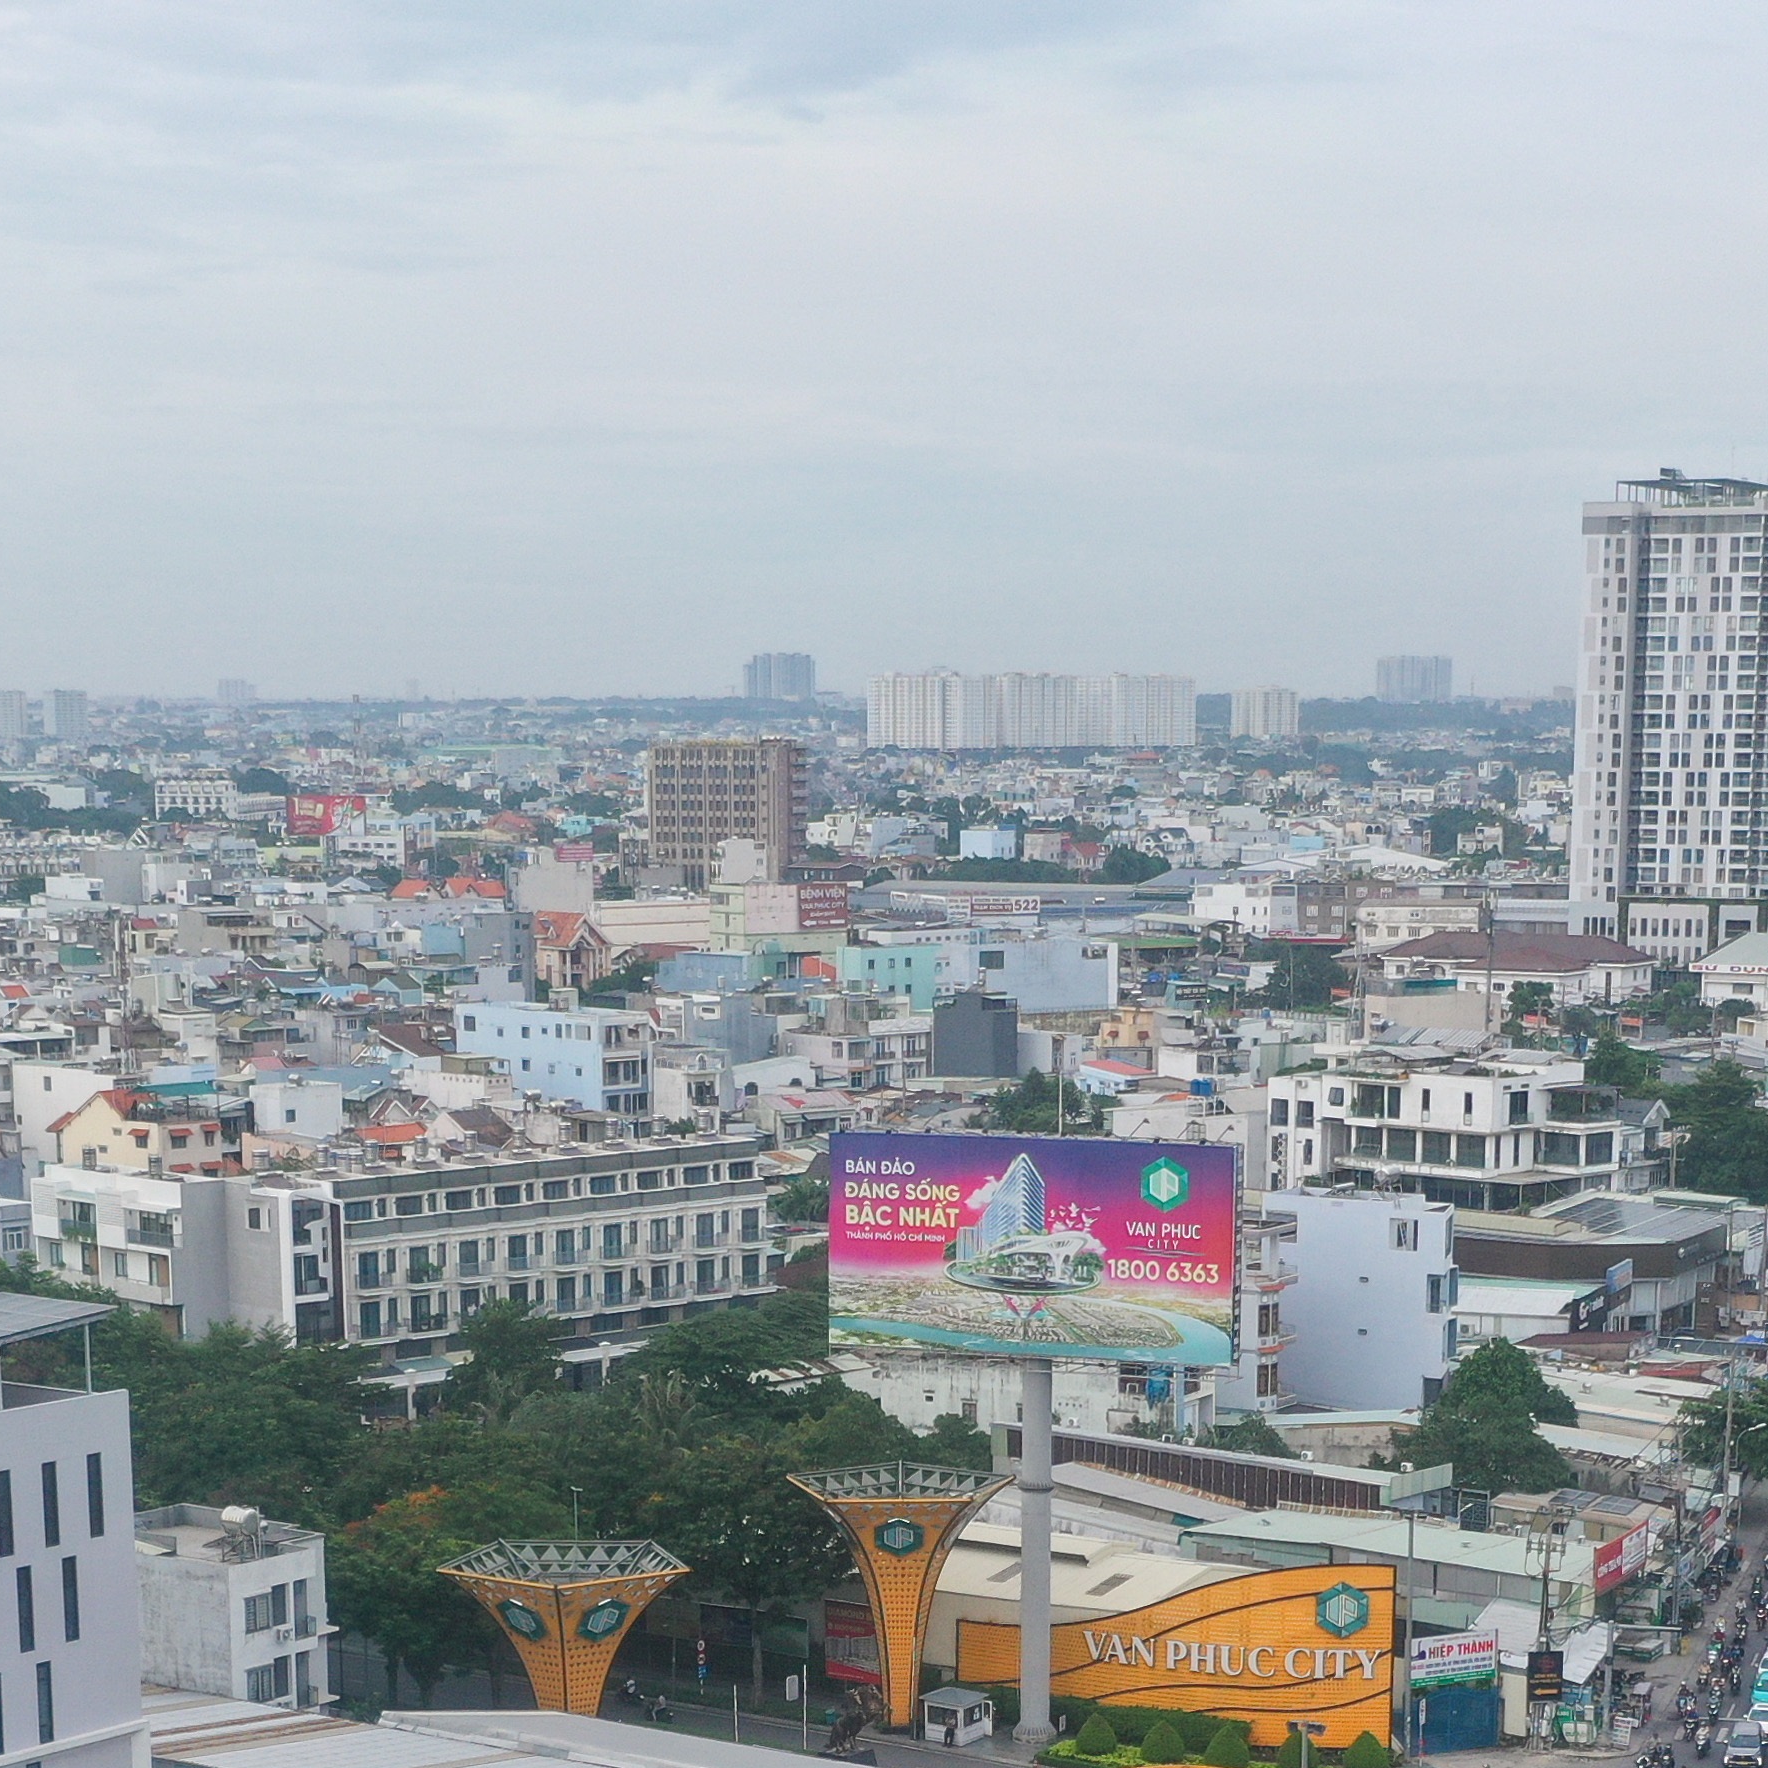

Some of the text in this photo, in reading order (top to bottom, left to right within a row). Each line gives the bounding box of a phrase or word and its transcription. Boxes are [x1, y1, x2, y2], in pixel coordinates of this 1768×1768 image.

[1014, 899, 1039, 911] 522
[845, 1157, 915, 1175] BÁN ĐẢO
[844, 1178, 960, 1202] ĐÁNG SỐNG
[845, 1201, 960, 1231] BẬC NHẤT
[845, 1230, 945, 1243] THÀNH PHỐ HỒ CHÍ MINH
[1126, 1221, 1201, 1239] VAN PHUC
[1147, 1239, 1179, 1249] CITY
[1107, 1259, 1219, 1284] 1800 6363
[1083, 1630, 1155, 1667] VAN
[1166, 1640, 1275, 1678] PHUC
[1284, 1648, 1381, 1680] CITY
[1428, 1639, 1493, 1661] HIỆP THÀNH
